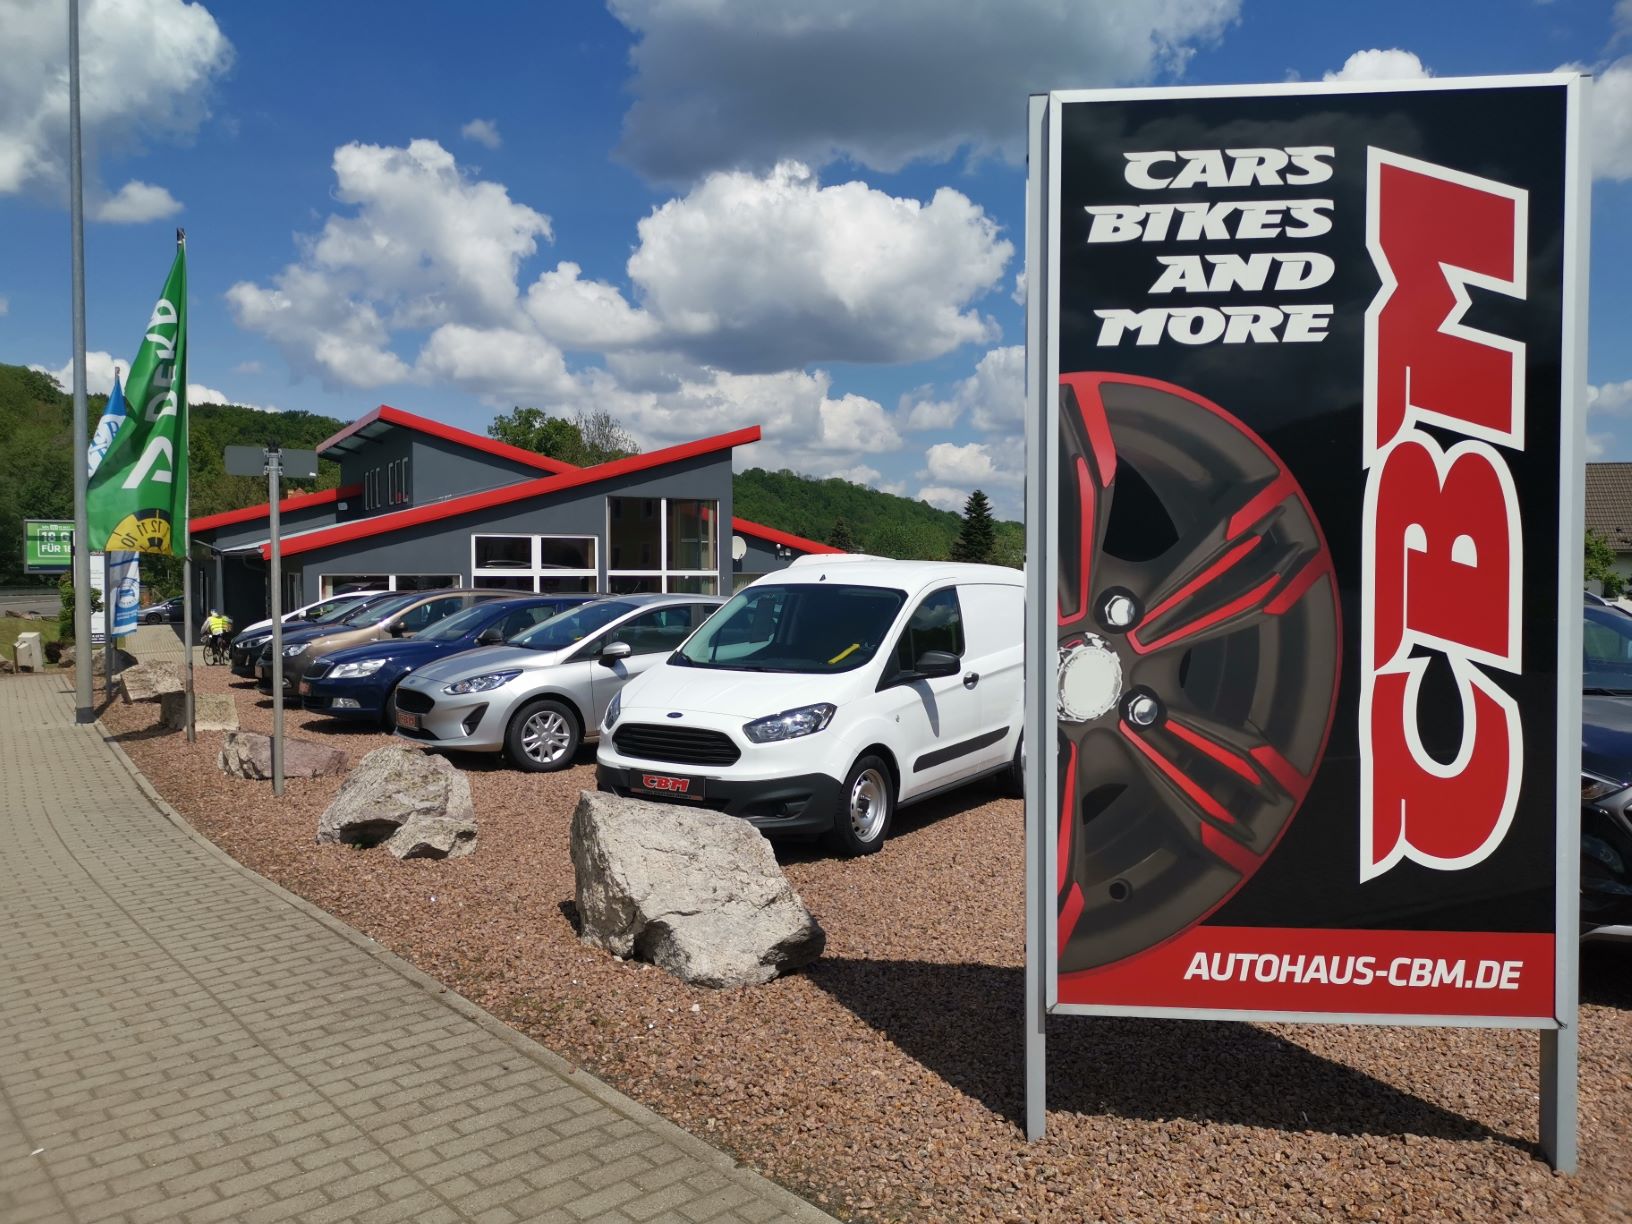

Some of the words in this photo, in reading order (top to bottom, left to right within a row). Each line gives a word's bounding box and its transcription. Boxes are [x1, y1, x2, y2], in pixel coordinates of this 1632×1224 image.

[1123, 146, 1335, 190] CARS
[1084, 199, 1334, 243] BIKES
[1147, 252, 1335, 294] AND
[1093, 304, 1334, 347] MORE
[1360, 145, 1528, 883] CBM
[41, 532, 56, 542] 18
[41, 543, 61, 552] FÜR
[642, 774, 690, 793] CBM
[1184, 952, 1524, 990] AUTOHAUS-CBM.DE
